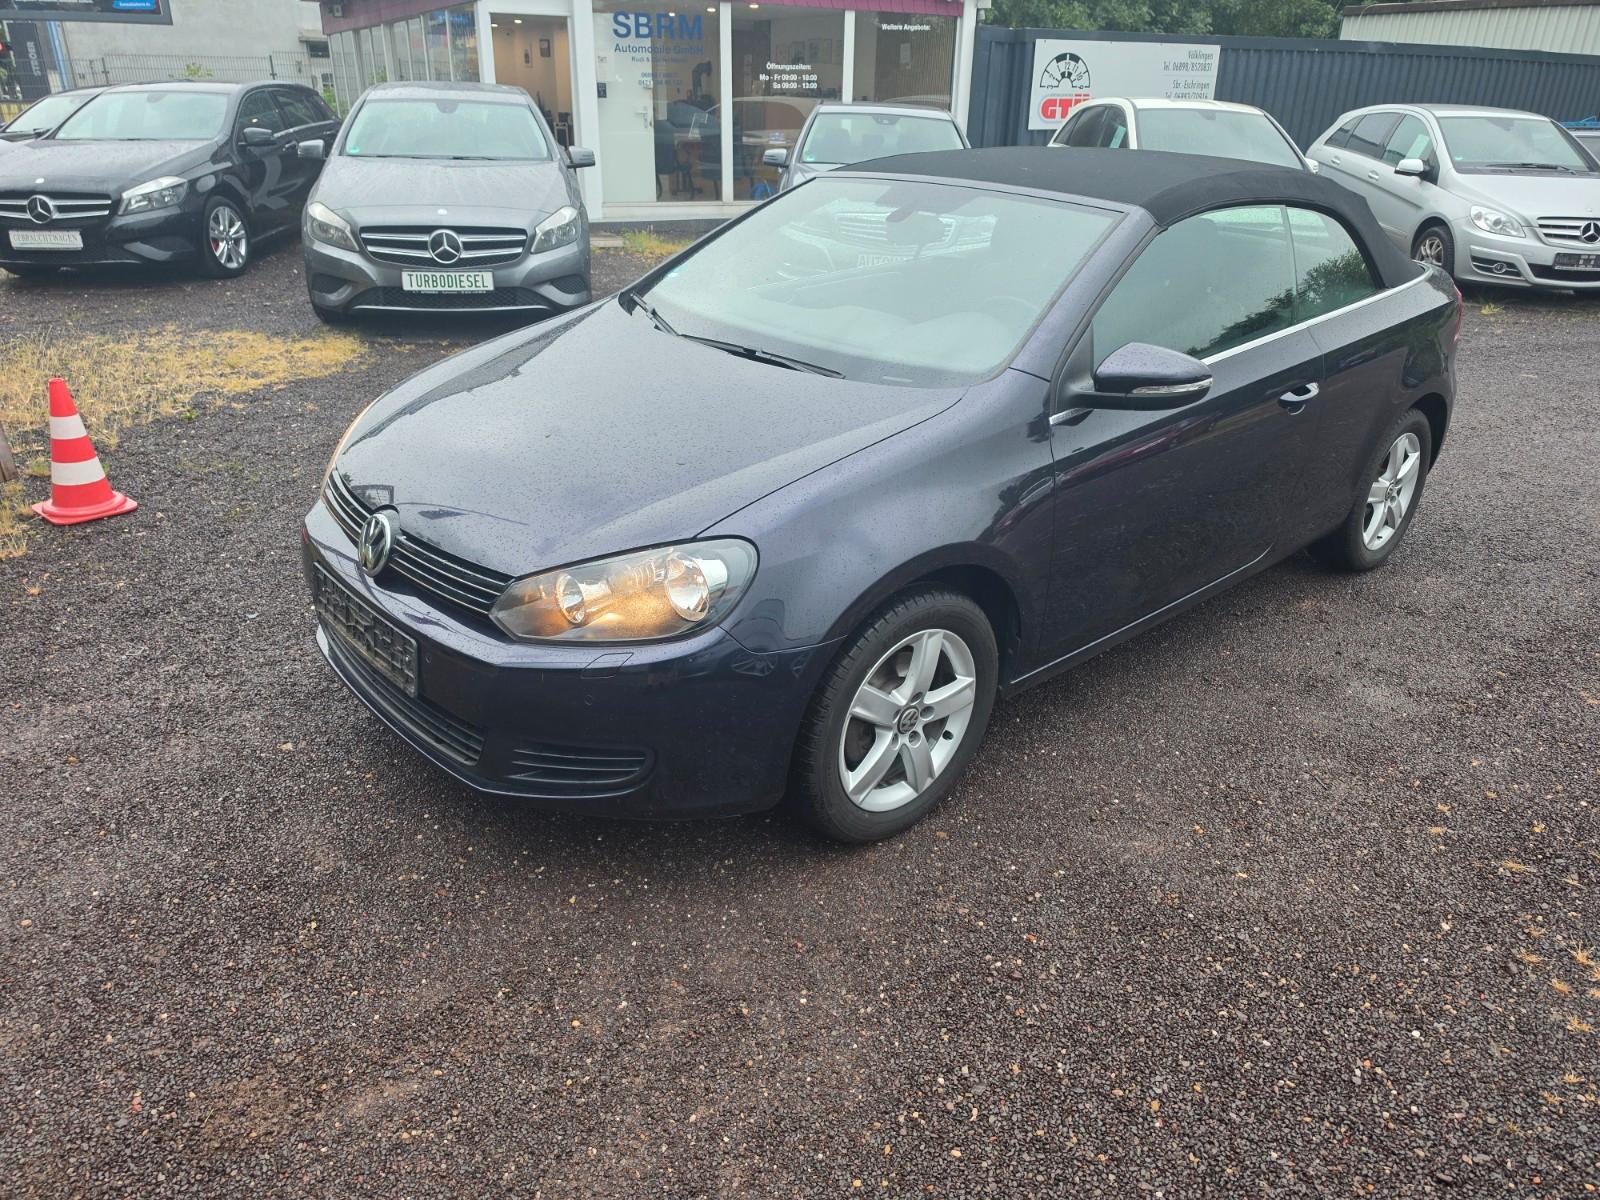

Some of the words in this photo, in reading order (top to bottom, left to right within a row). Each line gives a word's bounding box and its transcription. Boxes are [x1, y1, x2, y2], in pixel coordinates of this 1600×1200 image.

[613, 11, 704, 39] SBRM
[614, 43, 671, 55] Automobile
[673, 44, 704, 56] GmbH
[13, 234, 78, 242] GEBRAUCHTWAGEN
[408, 274, 488, 288] TURBODIESEL
